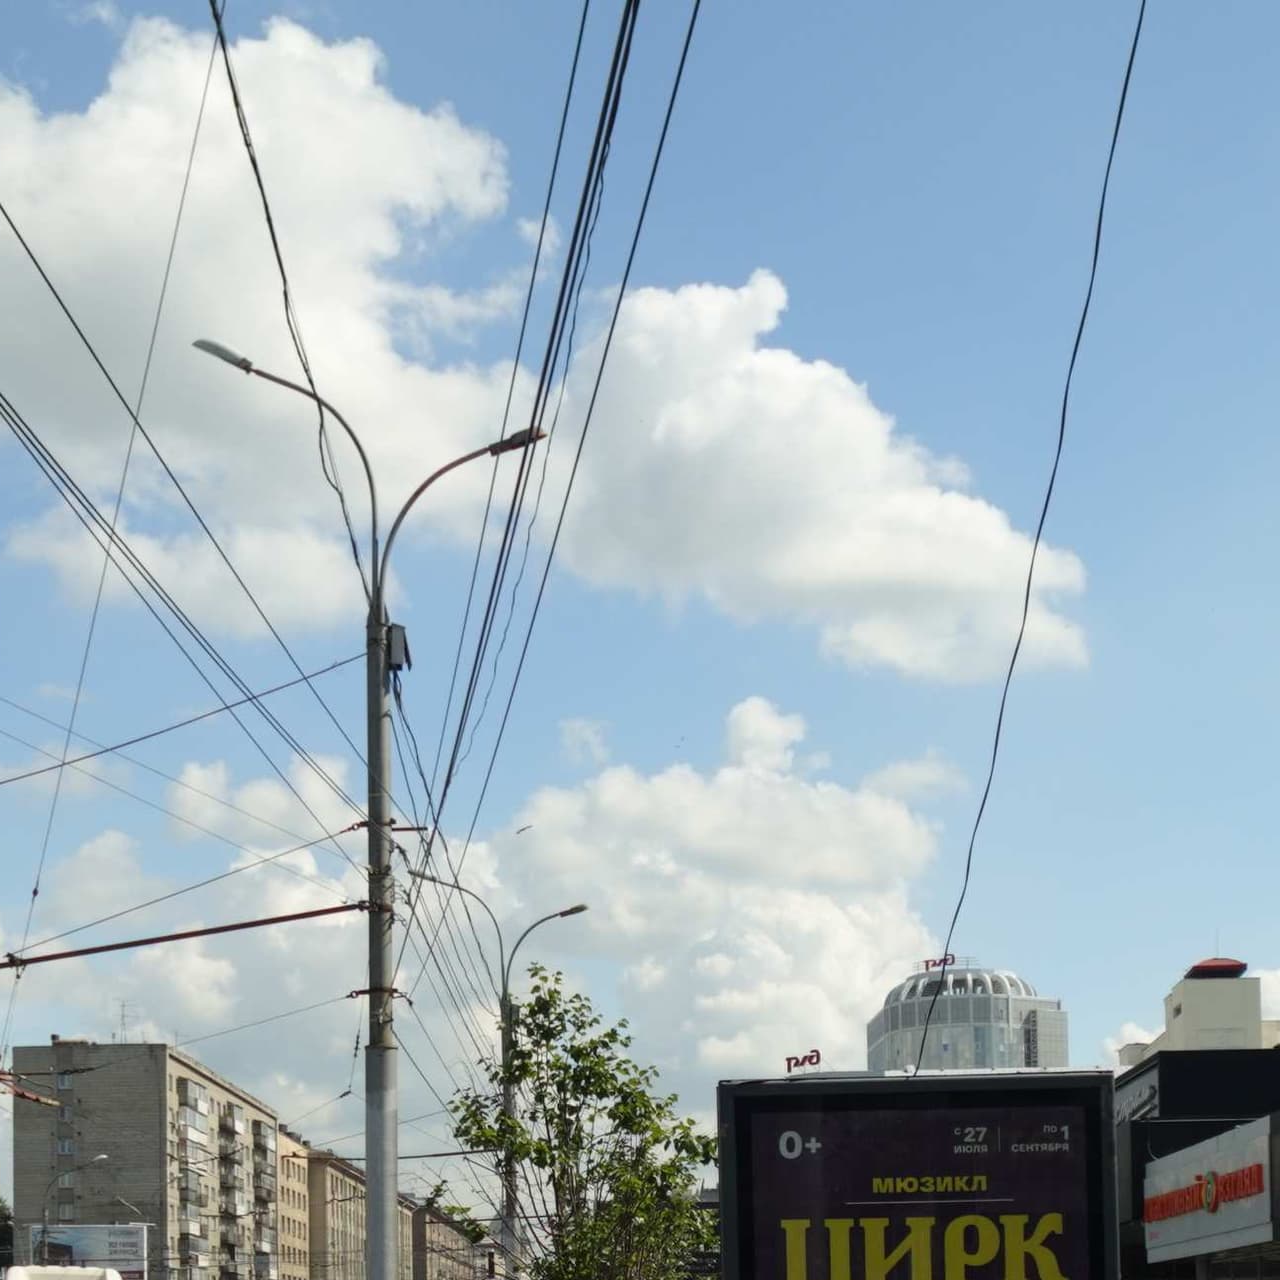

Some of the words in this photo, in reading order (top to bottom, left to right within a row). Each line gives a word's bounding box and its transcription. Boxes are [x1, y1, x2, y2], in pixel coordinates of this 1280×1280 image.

[963, 1127, 987, 1142] 27
[1043, 1125, 1058, 1133] ПО
[1060, 1125, 1069, 1140] 1
[778, 1130, 822, 1160] 0+
[953, 1144, 988, 1153] ИЮЛЯ
[1011, 1143, 1070, 1153] СЕНТЯБРЯ
[872, 1174, 988, 1194] МЮЗИКЛ
